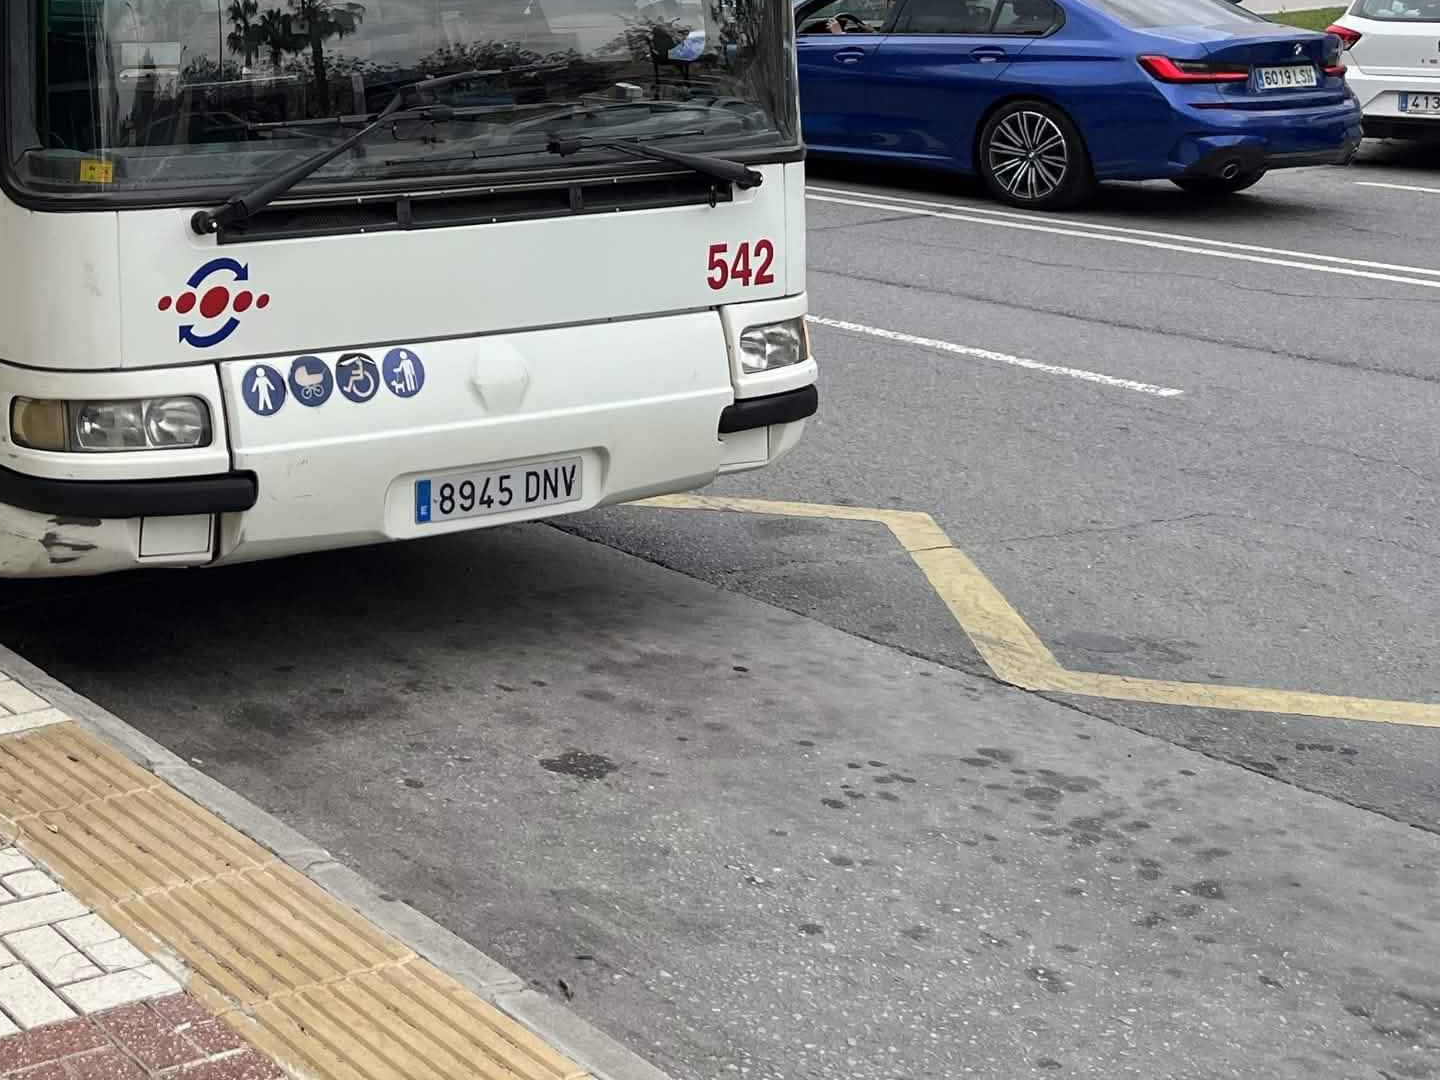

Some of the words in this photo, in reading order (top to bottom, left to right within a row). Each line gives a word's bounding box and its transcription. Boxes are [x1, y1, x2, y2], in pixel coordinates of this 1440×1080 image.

[1264, 70, 1291, 86] 6019
[707, 239, 774, 290] 542
[439, 475, 513, 515] 8945
[525, 465, 576, 503] DNV
